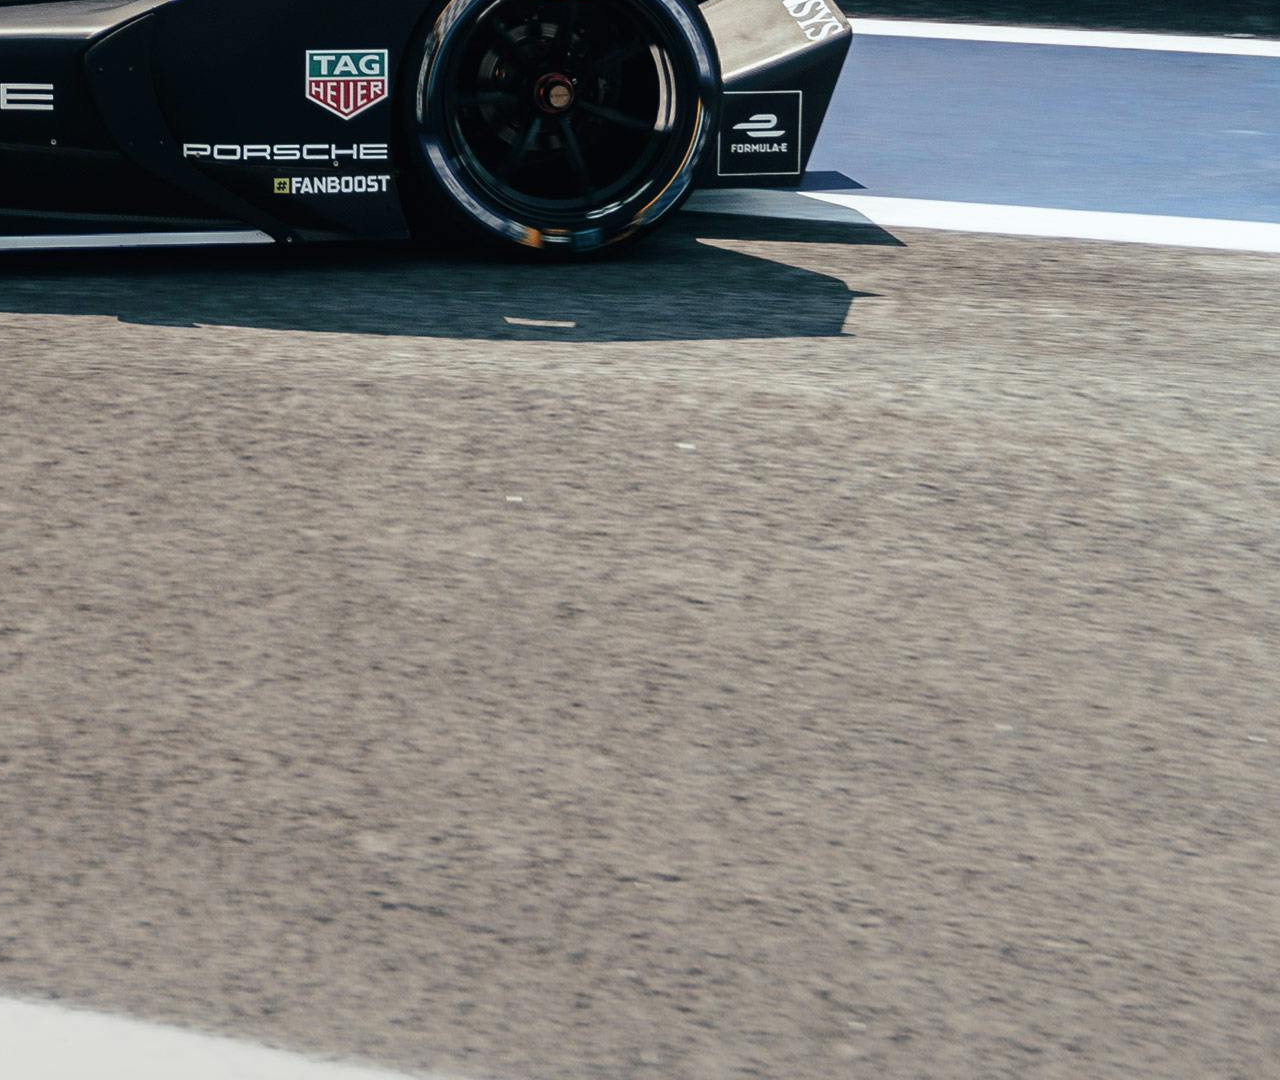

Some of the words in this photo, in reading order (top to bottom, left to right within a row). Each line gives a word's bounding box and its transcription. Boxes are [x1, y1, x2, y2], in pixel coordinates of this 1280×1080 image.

[312, 54, 381, 76] TAG
[310, 80, 384, 115] HEUER
[183, 143, 388, 160] PORSCHE
[273, 174, 391, 195] #FANBOOST
